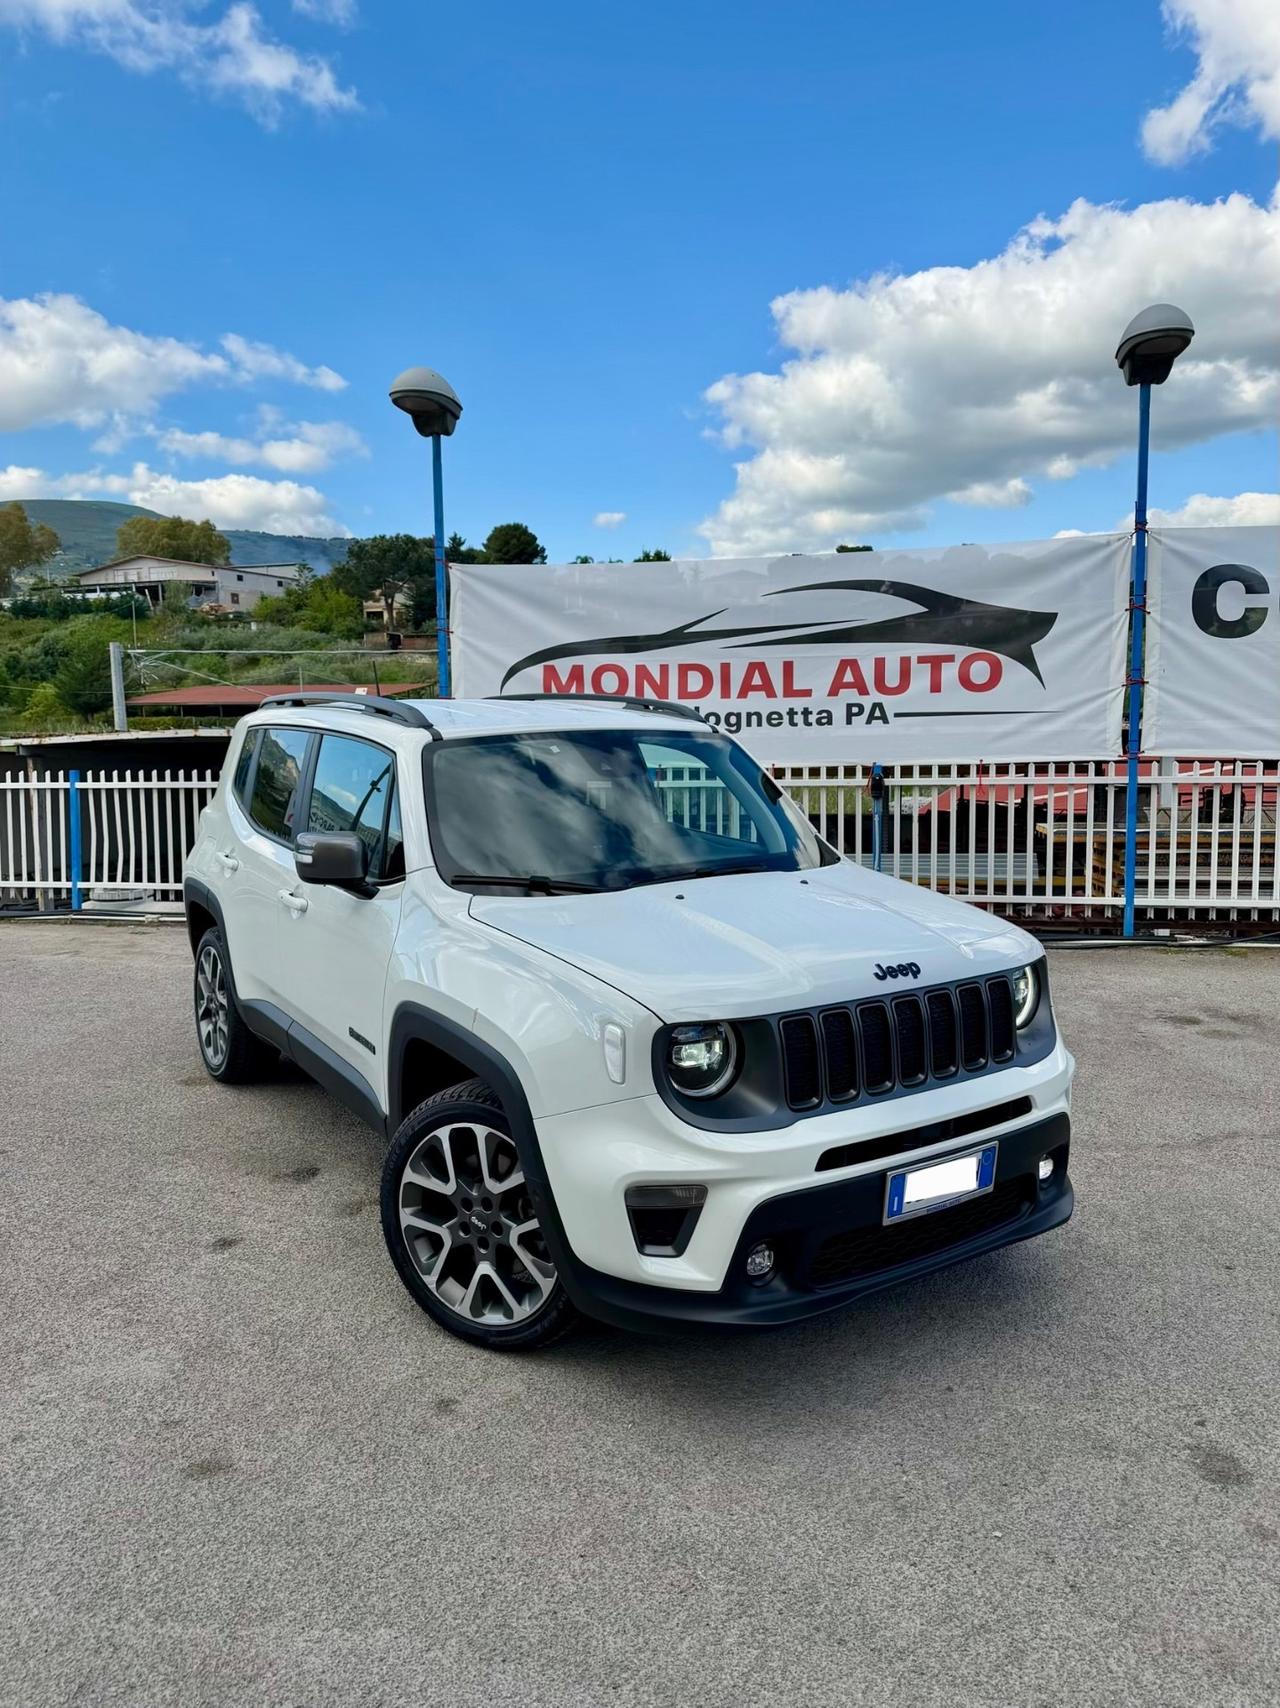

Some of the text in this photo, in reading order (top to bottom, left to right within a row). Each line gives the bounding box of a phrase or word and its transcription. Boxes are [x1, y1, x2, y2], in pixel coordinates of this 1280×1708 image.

[1192, 564, 1280, 638] C
[543, 652, 1003, 699] MONDIAL AUTO
[846, 702, 890, 726] PA
[873, 962, 921, 981] Jeep
